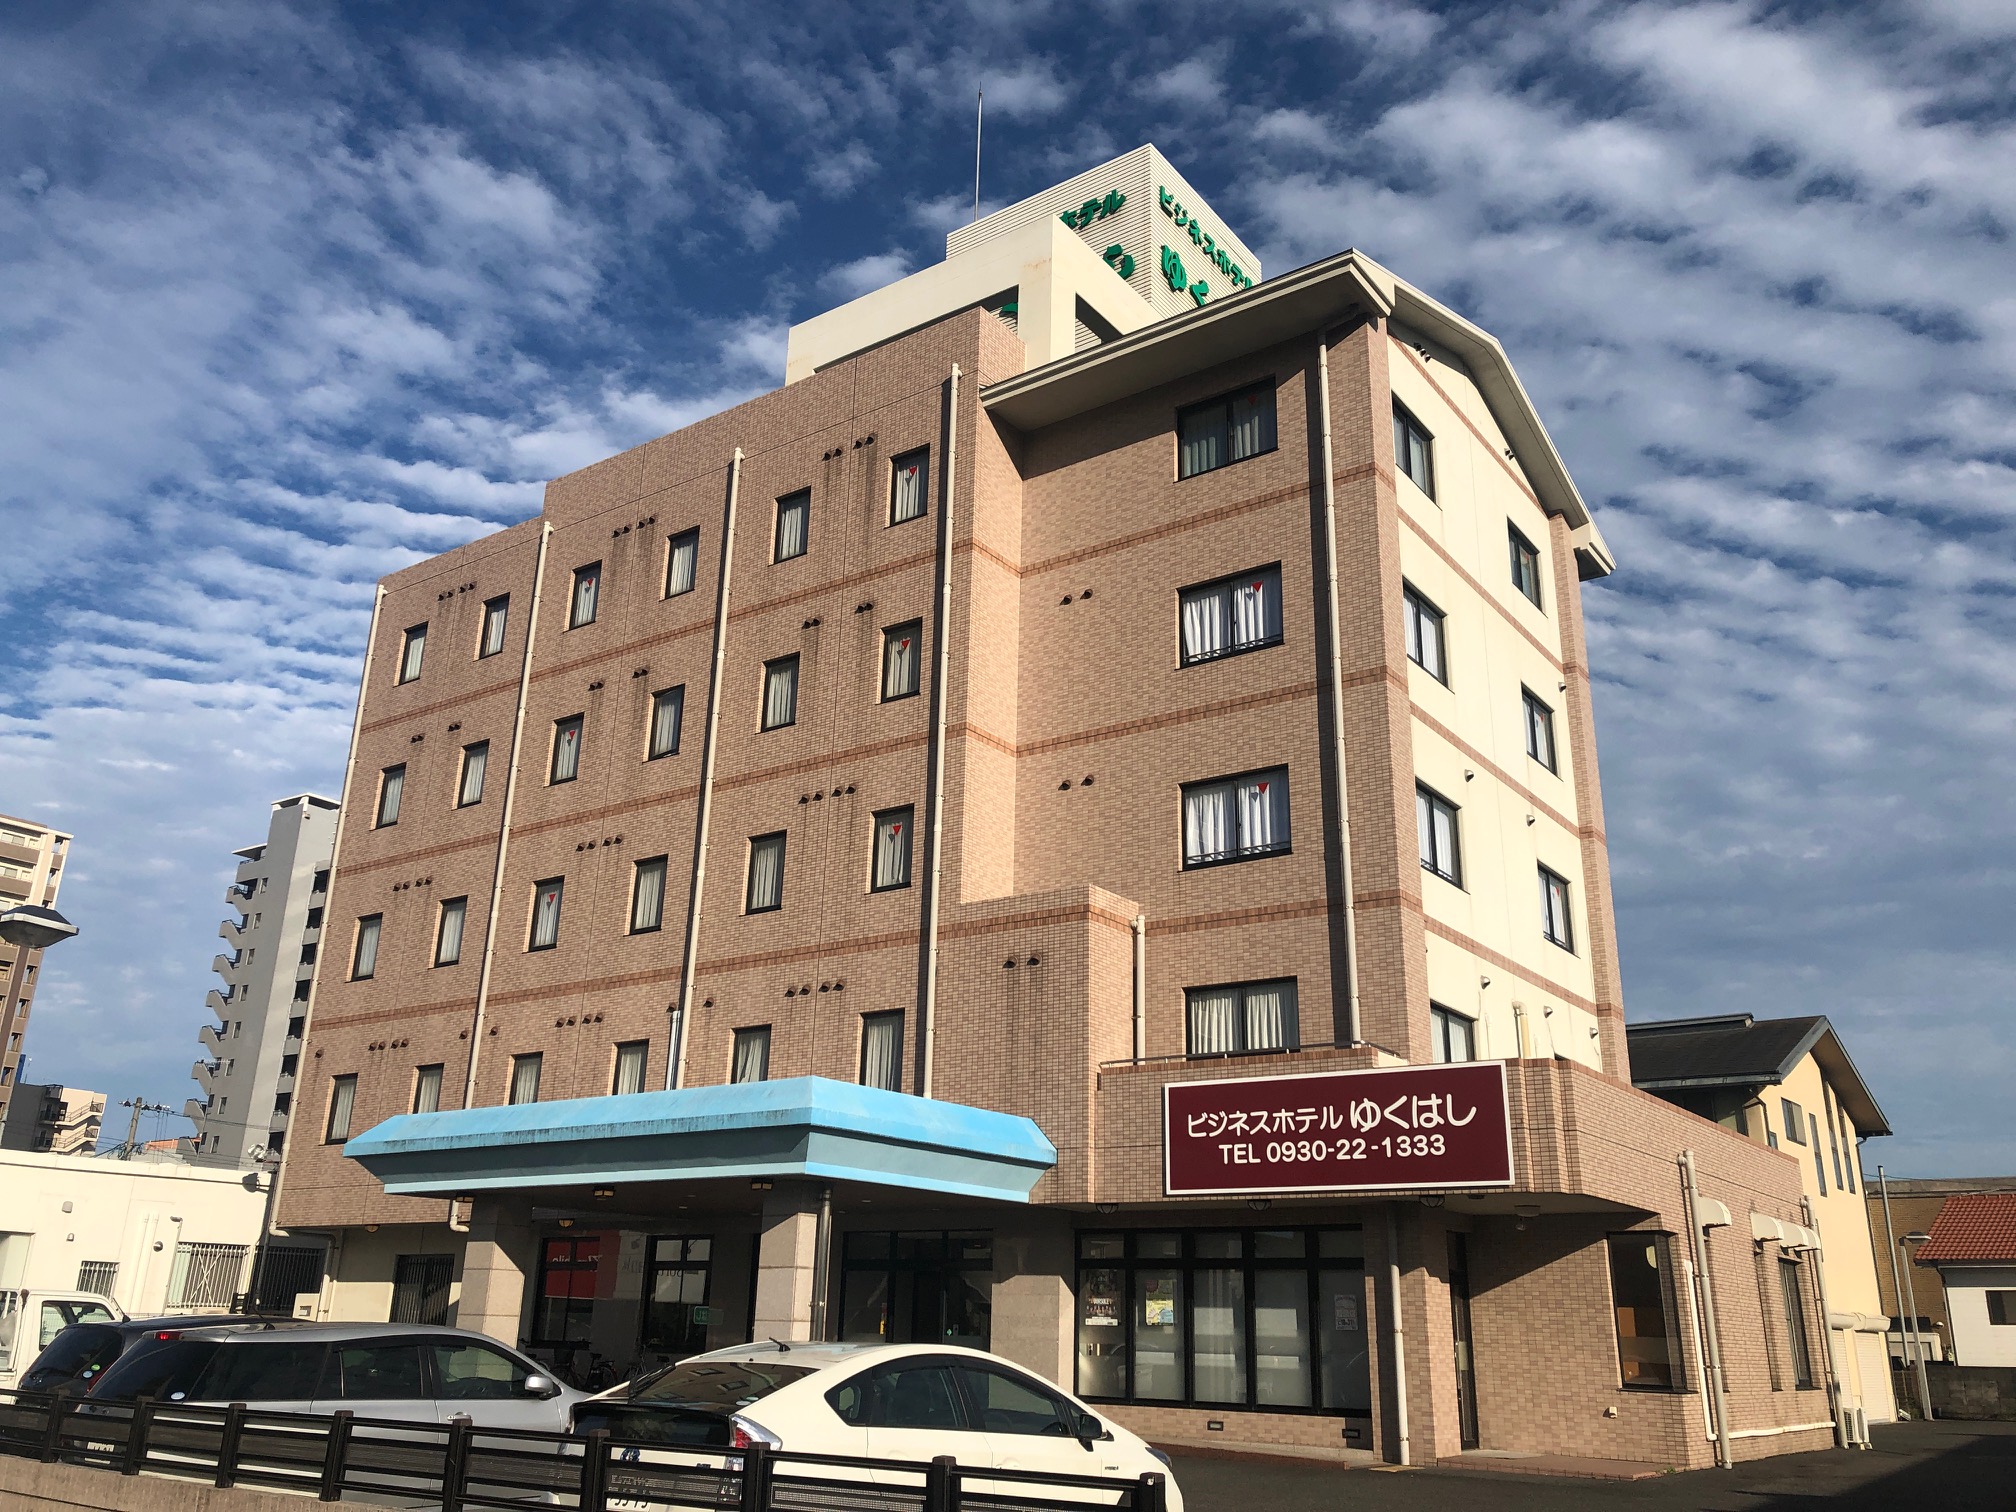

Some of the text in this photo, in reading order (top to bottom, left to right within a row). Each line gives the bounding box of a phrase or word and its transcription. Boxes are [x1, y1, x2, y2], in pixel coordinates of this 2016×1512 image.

[1187, 1093, 1477, 1138] ビジネスホテル ゆくはし
[1218, 1134, 1446, 1165] TEL 0930-22-1333
